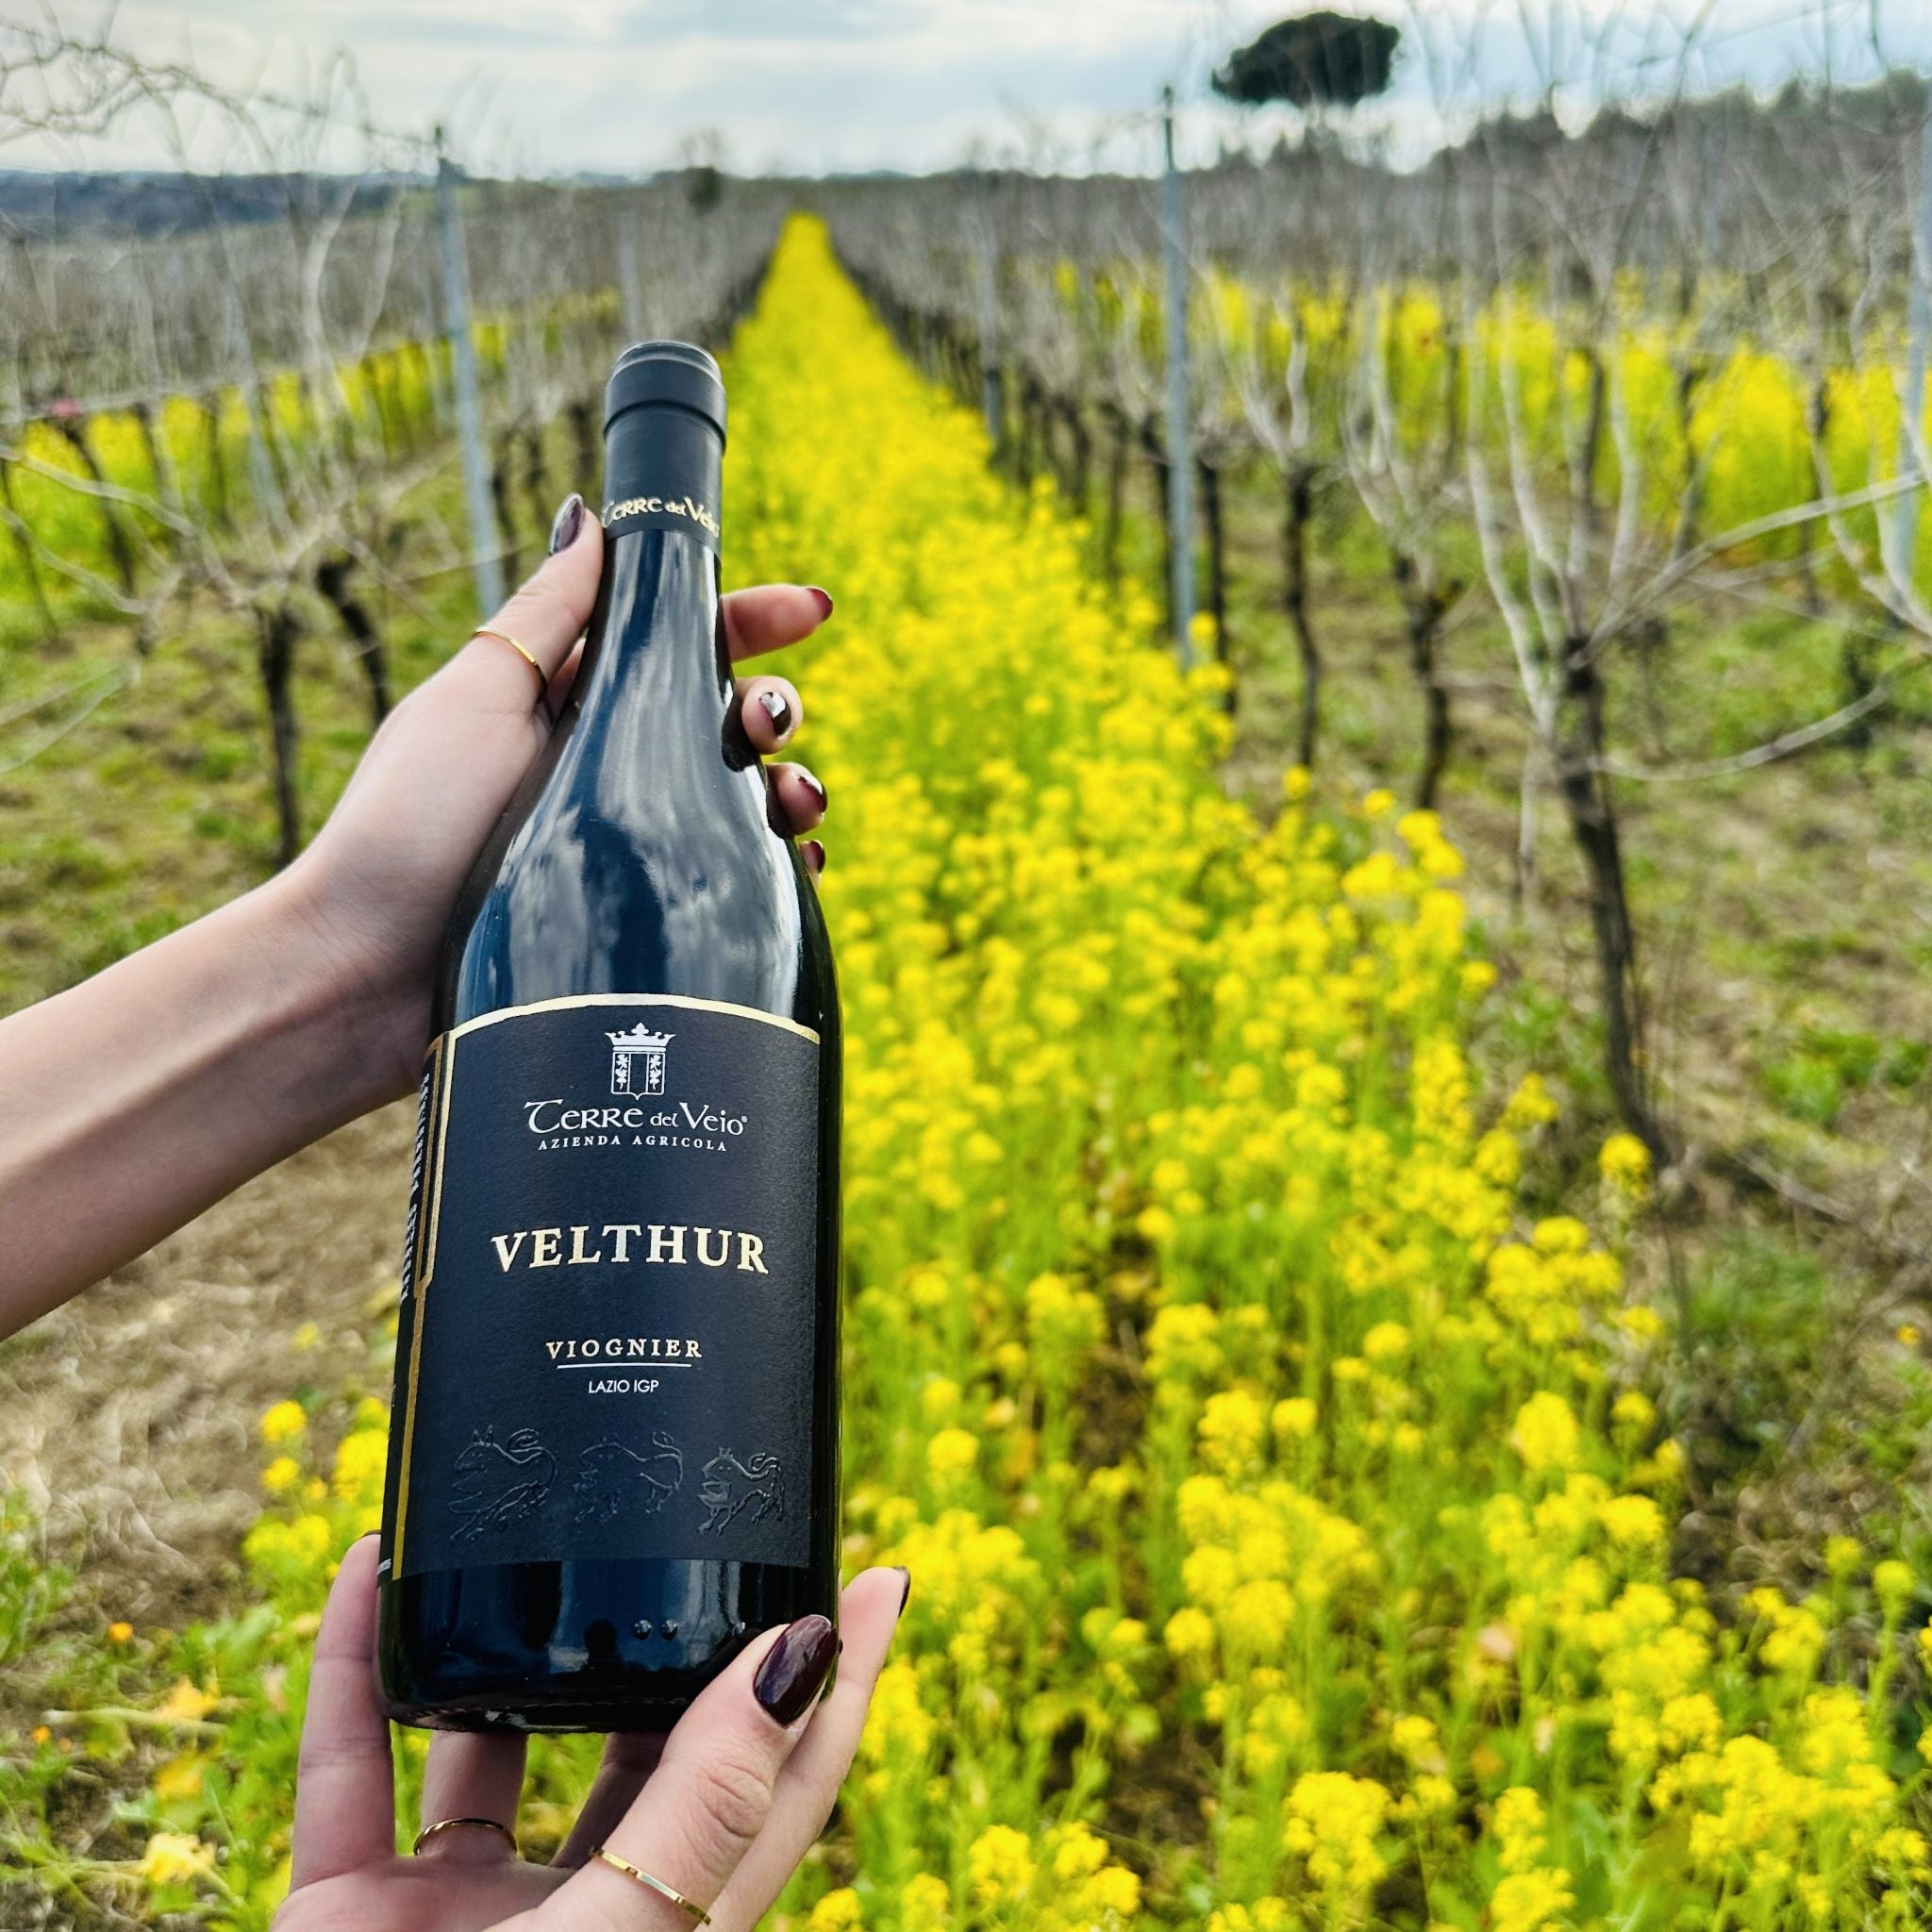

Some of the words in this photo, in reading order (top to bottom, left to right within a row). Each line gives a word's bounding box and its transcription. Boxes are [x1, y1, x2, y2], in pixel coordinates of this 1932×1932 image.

[649, 1111, 679, 1128] del
[538, 1135, 622, 1151] AZIENDA
[632, 1135, 727, 1152] AGRICOLA
[491, 1224, 770, 1274] VELTHUR
[545, 1338, 703, 1359] VIOGNIER
[588, 1379, 630, 1394] LAZIO
[633, 1379, 660, 1393] IGP
